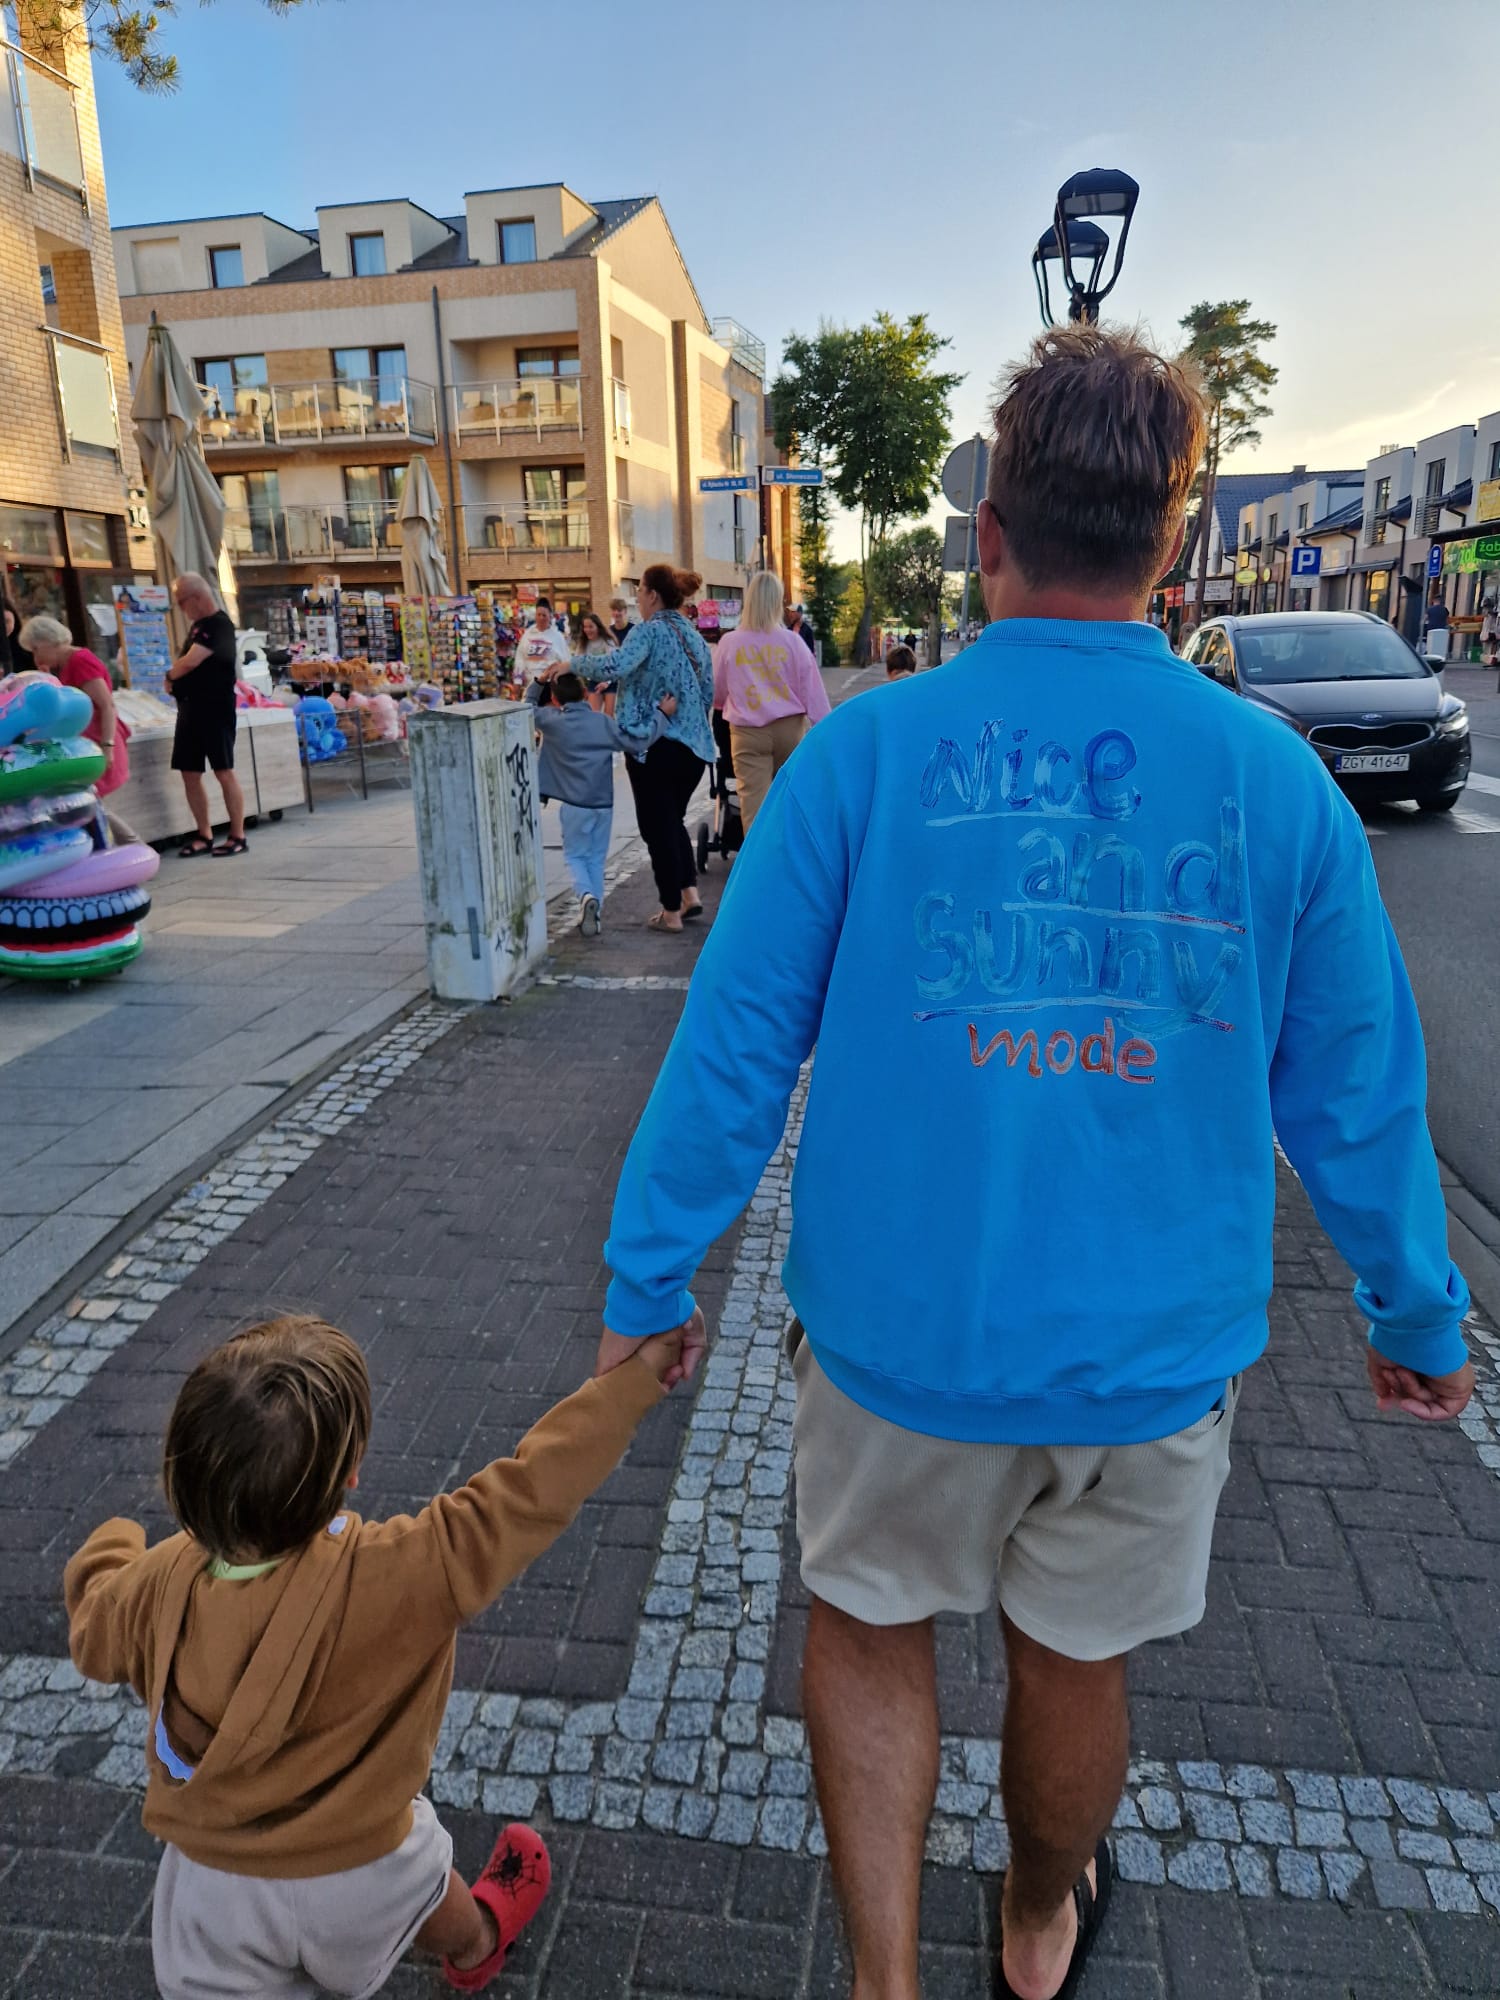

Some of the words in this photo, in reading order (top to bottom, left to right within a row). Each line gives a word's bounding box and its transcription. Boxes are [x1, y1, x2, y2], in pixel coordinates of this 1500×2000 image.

[1297, 550, 1315, 572] P
[919, 718, 1142, 822] Nice
[1342, 756, 1366, 769] ZGY
[1370, 755, 1408, 768] 41647
[1017, 796, 1245, 920] and
[914, 891, 1242, 1040] Sunny
[968, 1016, 1157, 1084] mode
